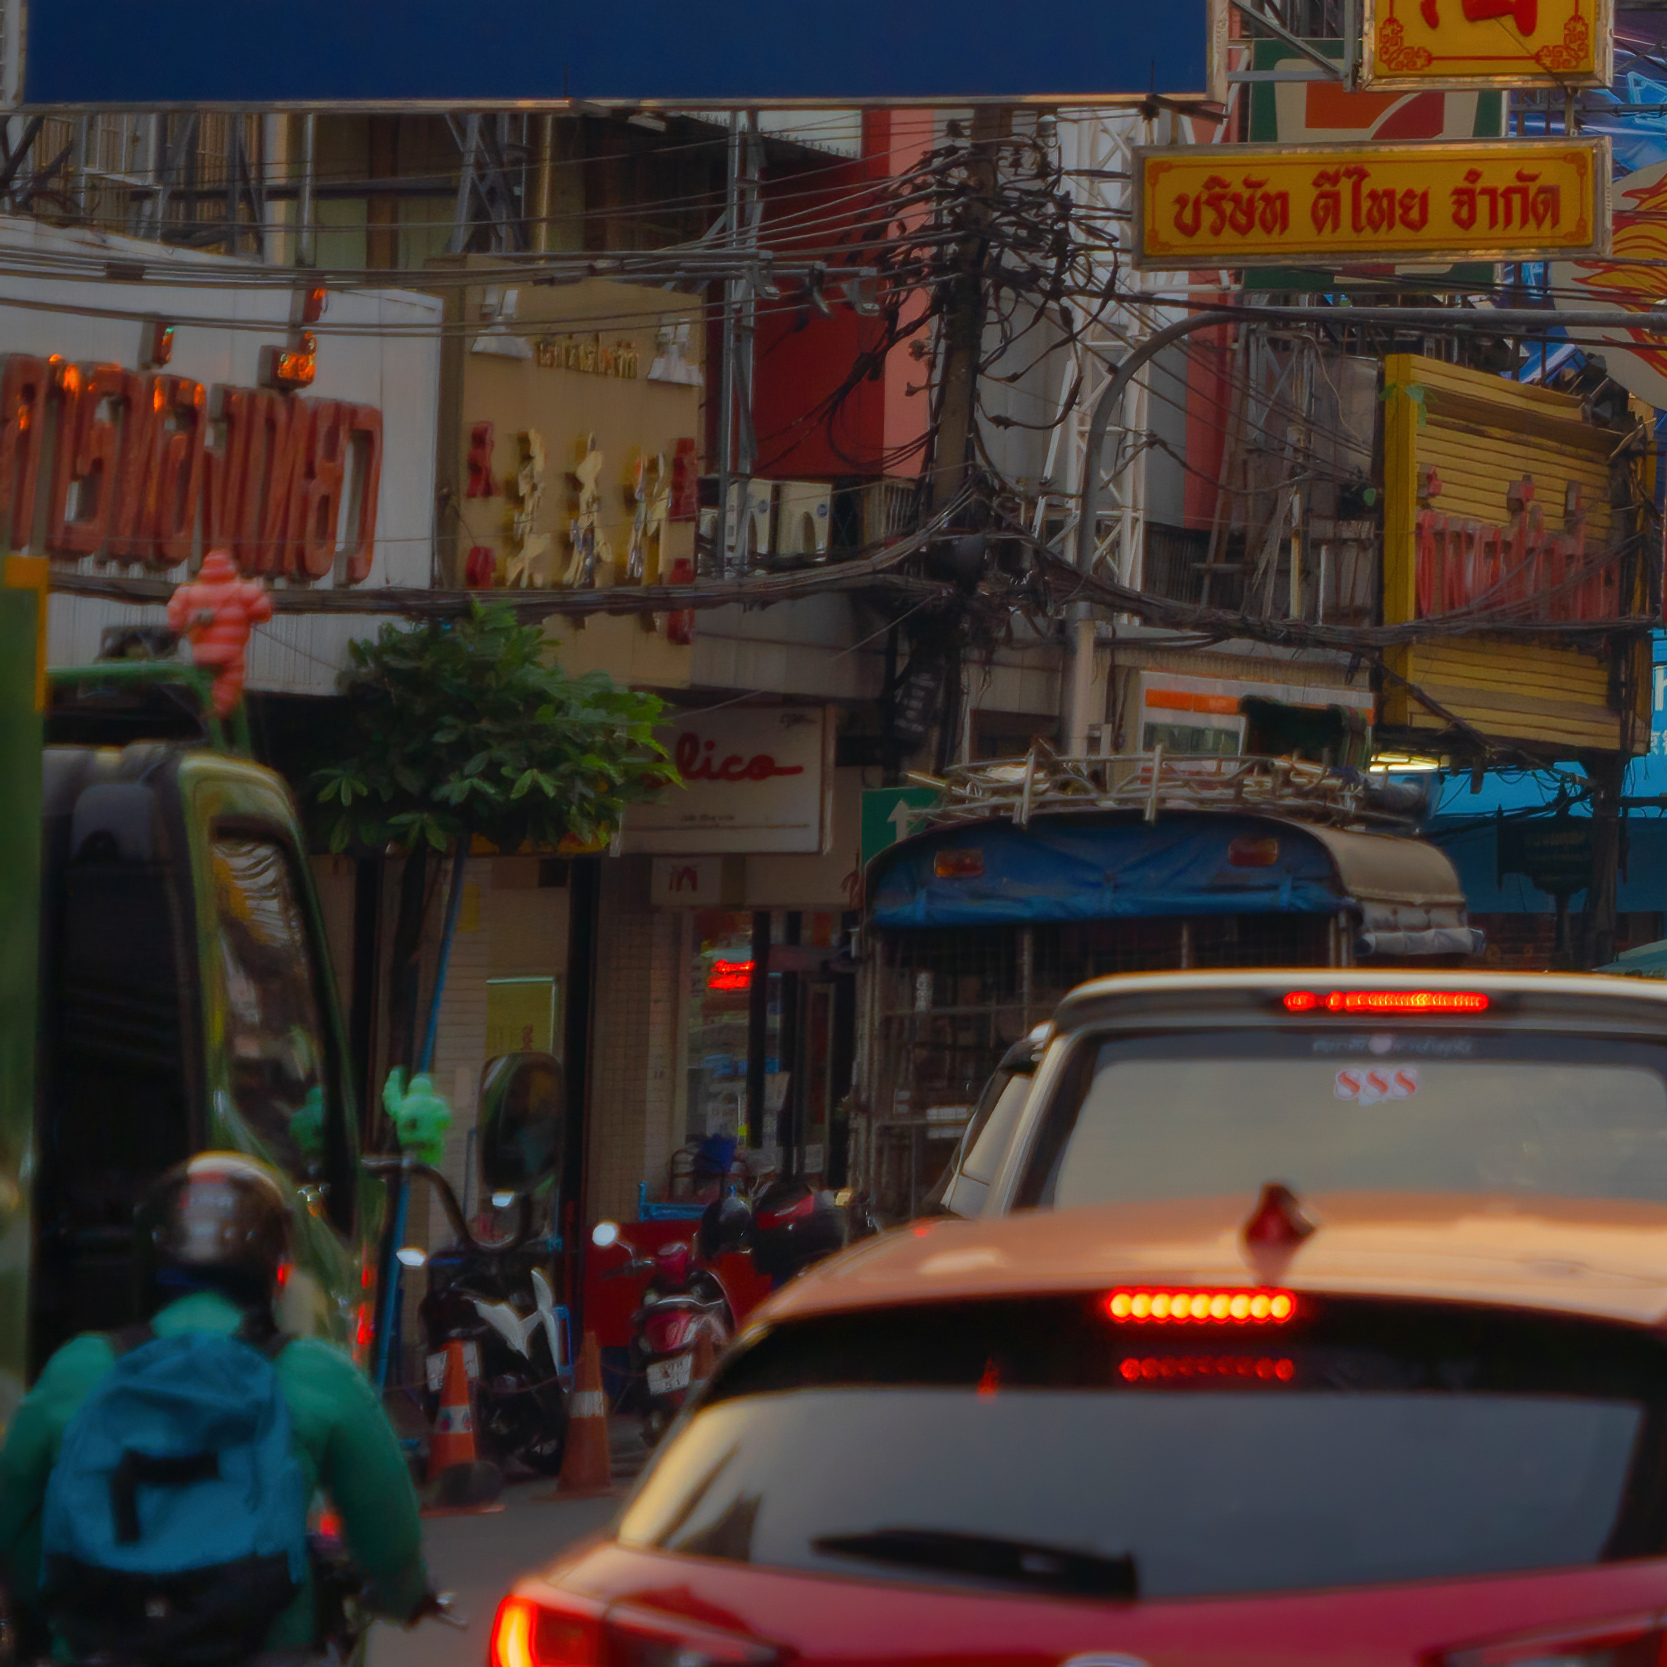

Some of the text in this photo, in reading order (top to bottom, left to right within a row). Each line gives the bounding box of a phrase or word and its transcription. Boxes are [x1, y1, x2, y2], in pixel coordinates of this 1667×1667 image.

[1172, 172, 1291, 238] บริษัท
[1451, 166, 1562, 233] จำกัด
